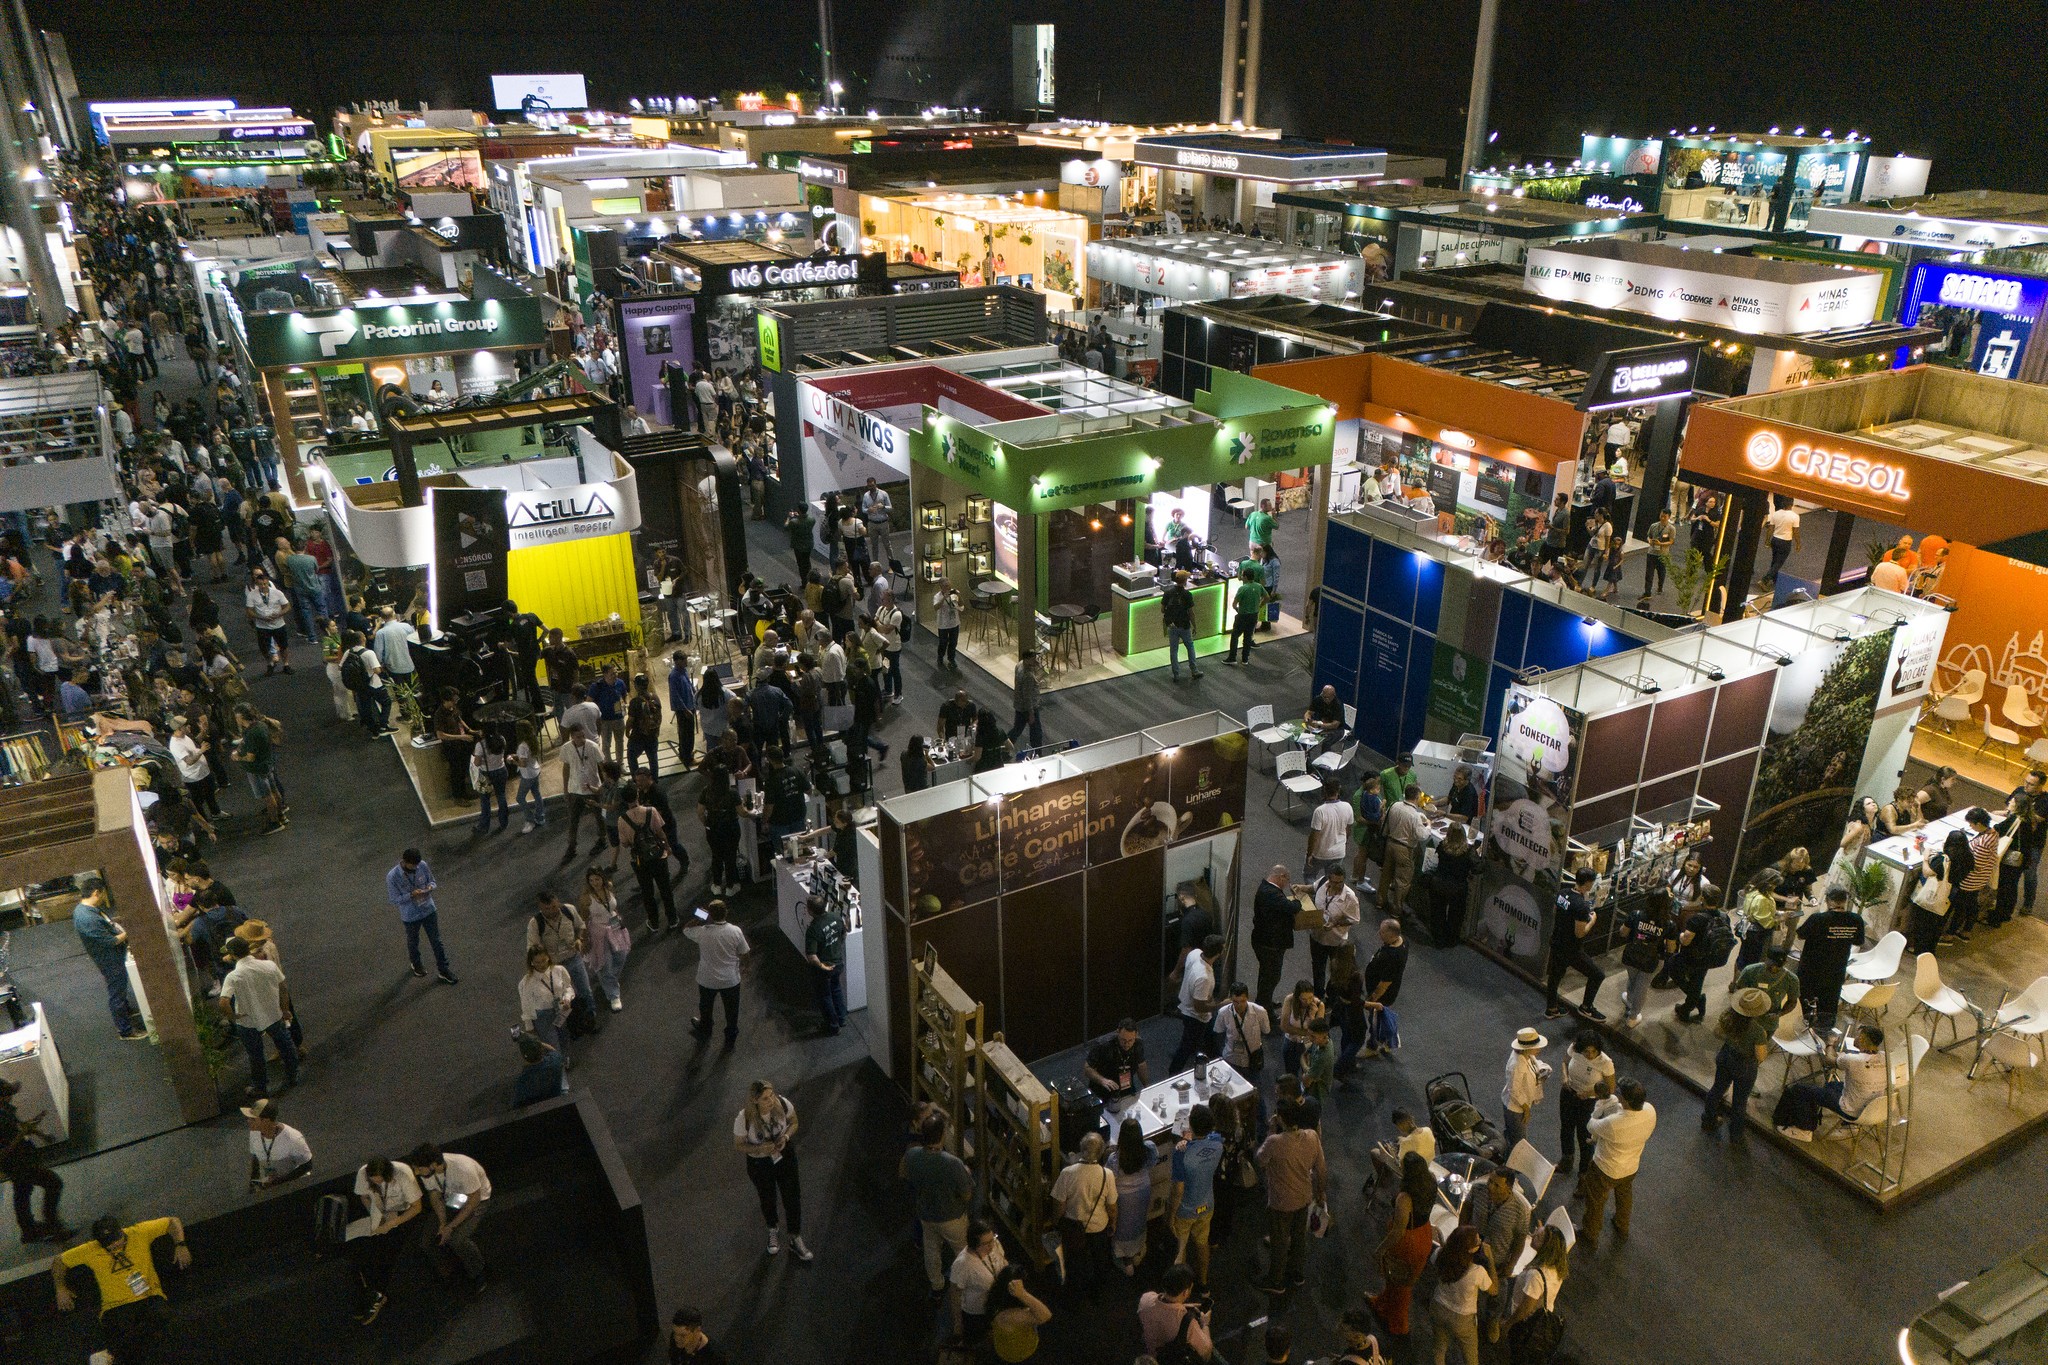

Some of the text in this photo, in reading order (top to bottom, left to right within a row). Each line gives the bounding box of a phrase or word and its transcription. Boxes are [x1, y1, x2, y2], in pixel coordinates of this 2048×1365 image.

[1177, 151, 1239, 170] ESPÍRITO SANTO
[1441, 239, 1500, 252] SALA DE CUPPING
[732, 259, 858, 288] Nó Cafézão!
[1158, 267, 1165, 286] 2
[900, 280, 957, 293] Concurso
[1634, 286, 1664, 299] BDMG
[1819, 288, 1848, 299] MINAS
[1941, 273, 2021, 310] SATAKE
[624, 302, 692, 315] Happy Cupping
[1680, 293, 1713, 305] CODEMGE
[1732, 296, 1759, 306] MINAS
[1816, 300, 1849, 313] GERAIS
[1731, 304, 1761, 315] GERAIS
[362, 317, 498, 340] Pacorini Group
[1261, 423, 1323, 442] Rovensa
[958, 438, 996, 470] Rovensa
[1260, 443, 1297, 460] Next
[1788, 446, 1909, 498] CRESOL
[515, 521, 612, 541] Intelligent Roaster
[2008, 557, 2034, 571] trem
[1901, 662, 1929, 683] DO CAFÉ
[1520, 723, 1562, 752] CONECTAR
[1186, 788, 1222, 804] Linhares
[975, 789, 1086, 842] Linhares
[1023, 812, 1115, 860] Conilon
[1501, 824, 1549, 859] FORTALECER
[1492, 896, 1539, 931] PROMOVER
[1638, 920, 1664, 937] BLUM'S
